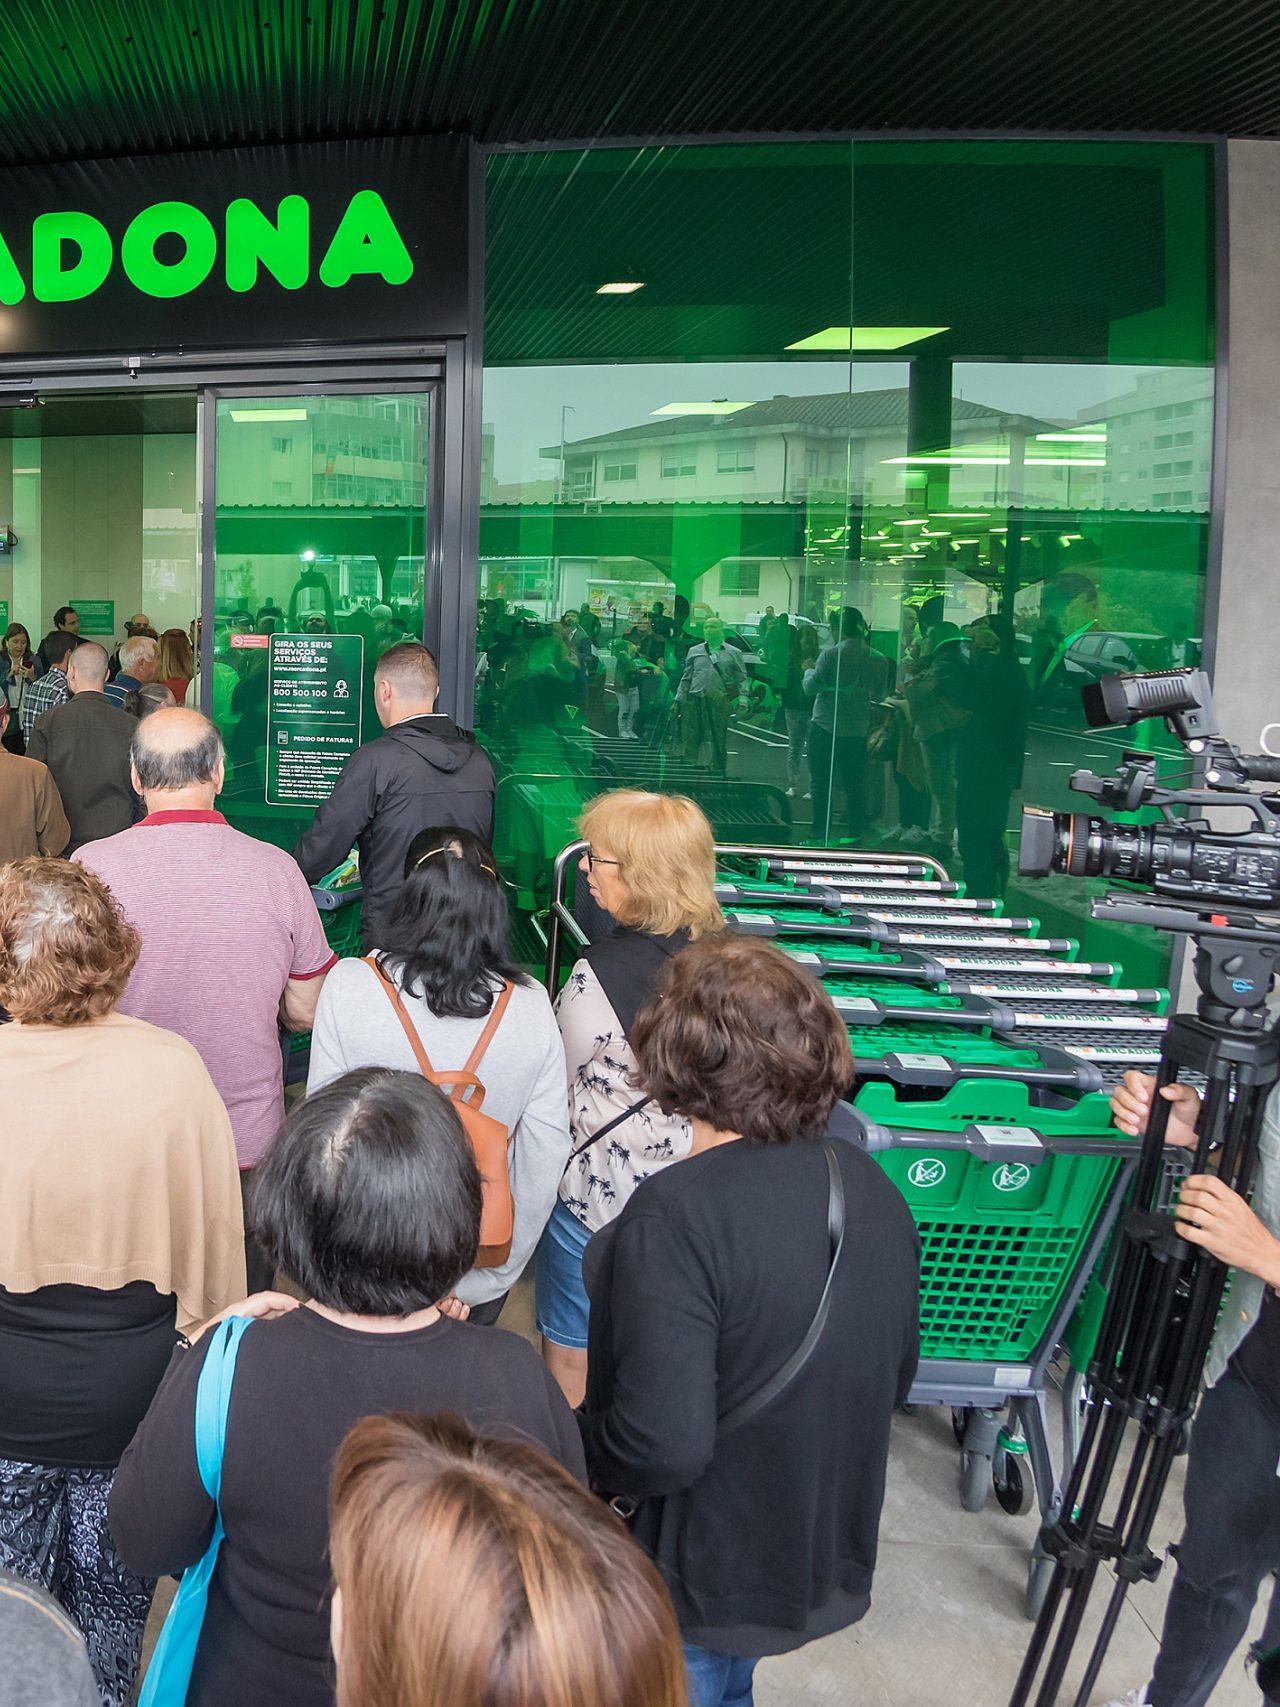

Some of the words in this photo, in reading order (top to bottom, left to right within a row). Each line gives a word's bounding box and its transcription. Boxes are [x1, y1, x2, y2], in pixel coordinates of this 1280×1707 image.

[310, 641, 333, 649] SEUS
[274, 648, 317, 656] SERVIÇOS
[273, 655, 313, 663] ATRAVÉS
[273, 688, 291, 696] 800
[292, 689, 310, 697] 500
[311, 689, 327, 697] 100
[892, 912, 949, 920] MERCADONA
[923, 934, 984, 942] MERCADONA
[960, 958, 1023, 966] MERCADONA
[996, 985, 1063, 993] MERCADONA
[1044, 1013, 1113, 1023] MERCADONA
[1095, 1047, 1162, 1056] MERCADON
